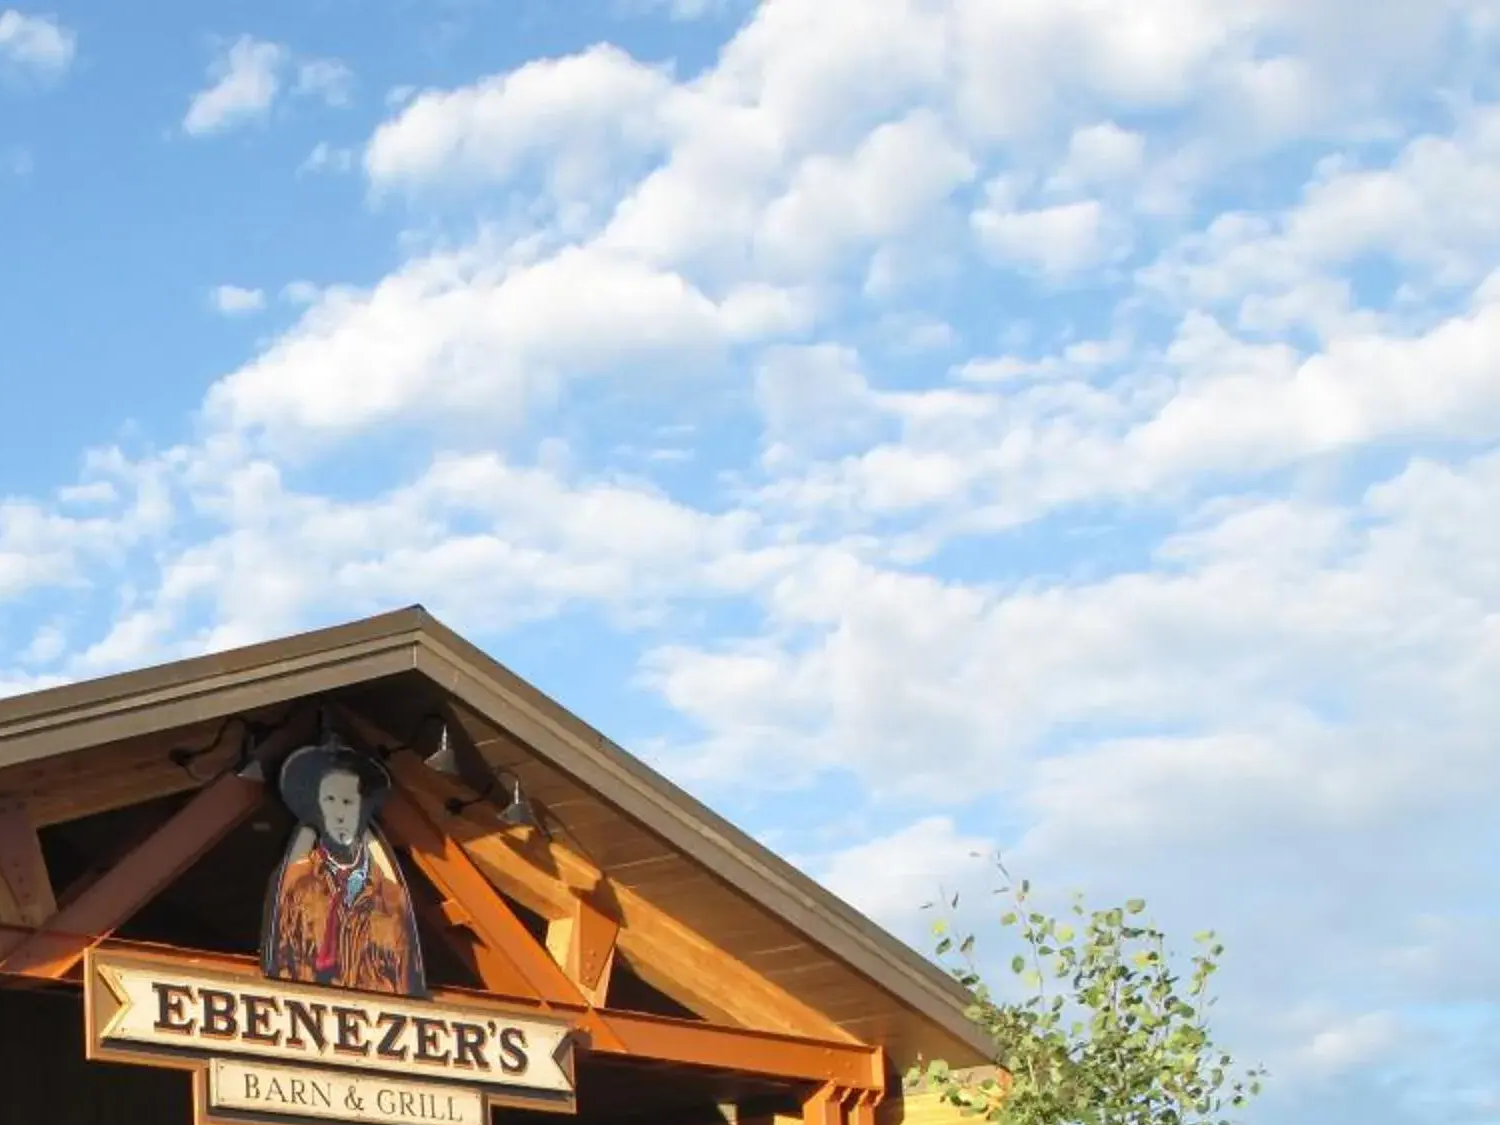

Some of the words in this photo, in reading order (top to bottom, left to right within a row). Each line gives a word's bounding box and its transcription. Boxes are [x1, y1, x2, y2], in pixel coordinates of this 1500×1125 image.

[152, 982, 529, 1074] EBENEZER'S
[244, 1073, 332, 1108] BARN
[343, 1085, 365, 1111] &
[376, 1089, 463, 1123] GRILL
